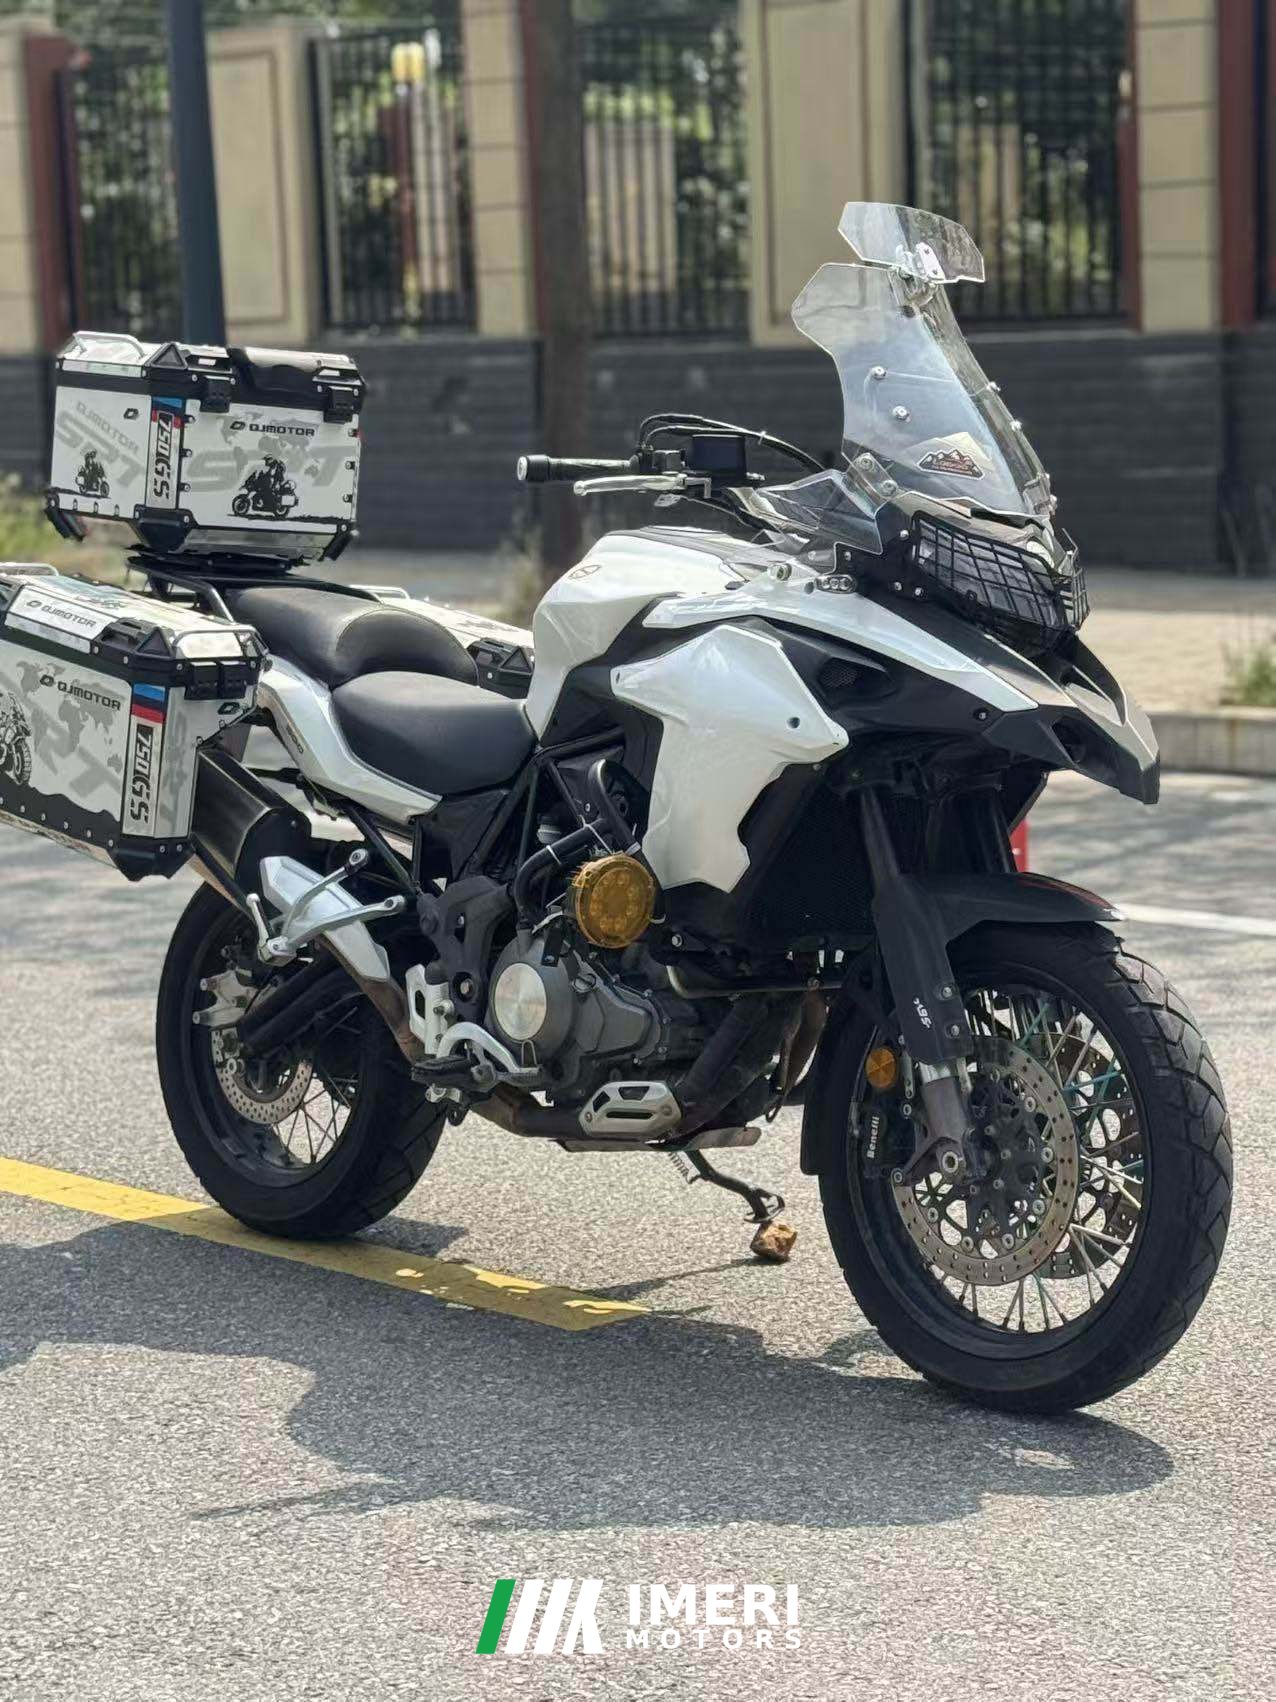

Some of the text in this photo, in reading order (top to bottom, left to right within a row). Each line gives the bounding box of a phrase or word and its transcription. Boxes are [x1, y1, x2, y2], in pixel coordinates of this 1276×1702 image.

[249, 423, 316, 437] QJMOTOR
[41, 604, 97, 628] QJMOTOR
[57, 681, 122, 711] QJMOTOR
[866, 1116, 880, 1159] Benelli
